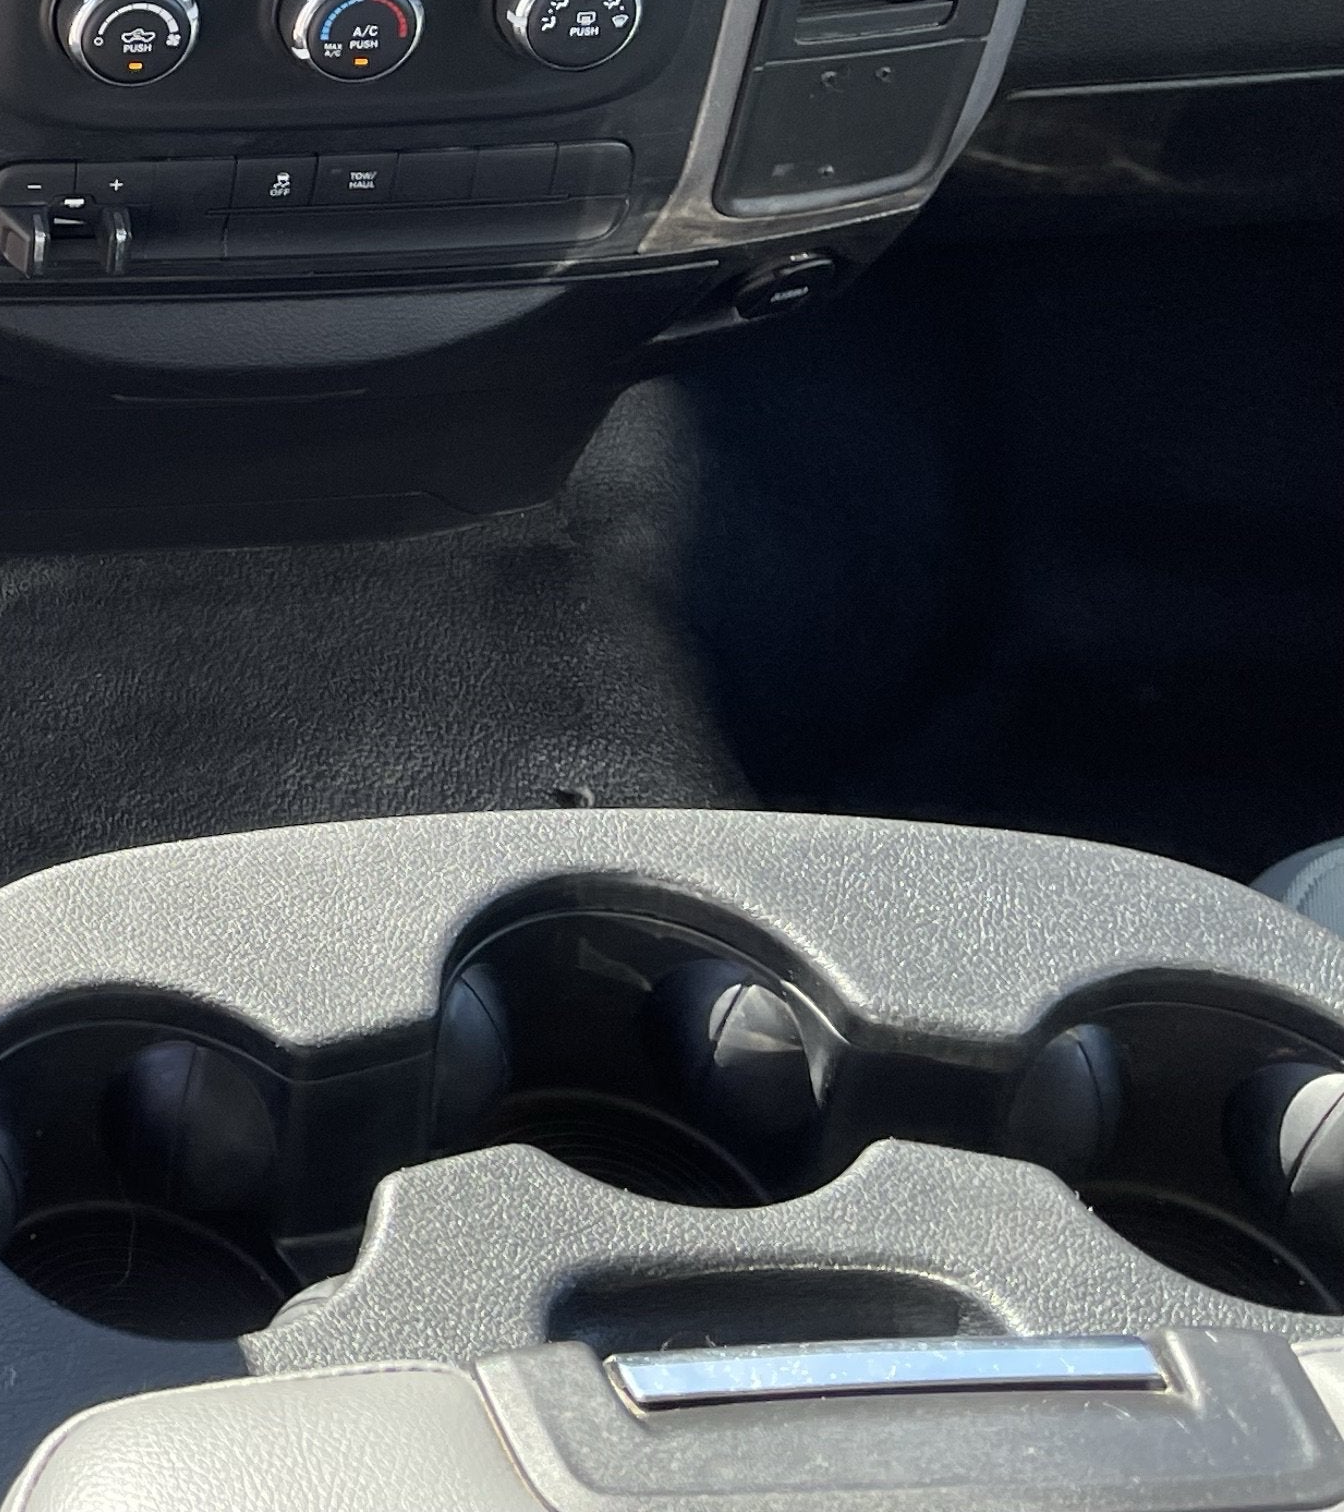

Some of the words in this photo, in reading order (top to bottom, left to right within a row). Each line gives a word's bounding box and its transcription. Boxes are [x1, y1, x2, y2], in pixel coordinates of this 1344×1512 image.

[353, 24, 378, 38] A/C
[569, 26, 600, 37] PUSH
[123, 43, 153, 53] PUSH
[349, 39, 378, 50] PUSH
[324, 49, 341, 57] A/C
[350, 172, 378, 181] TOW/
[270, 189, 291, 197] OFF
